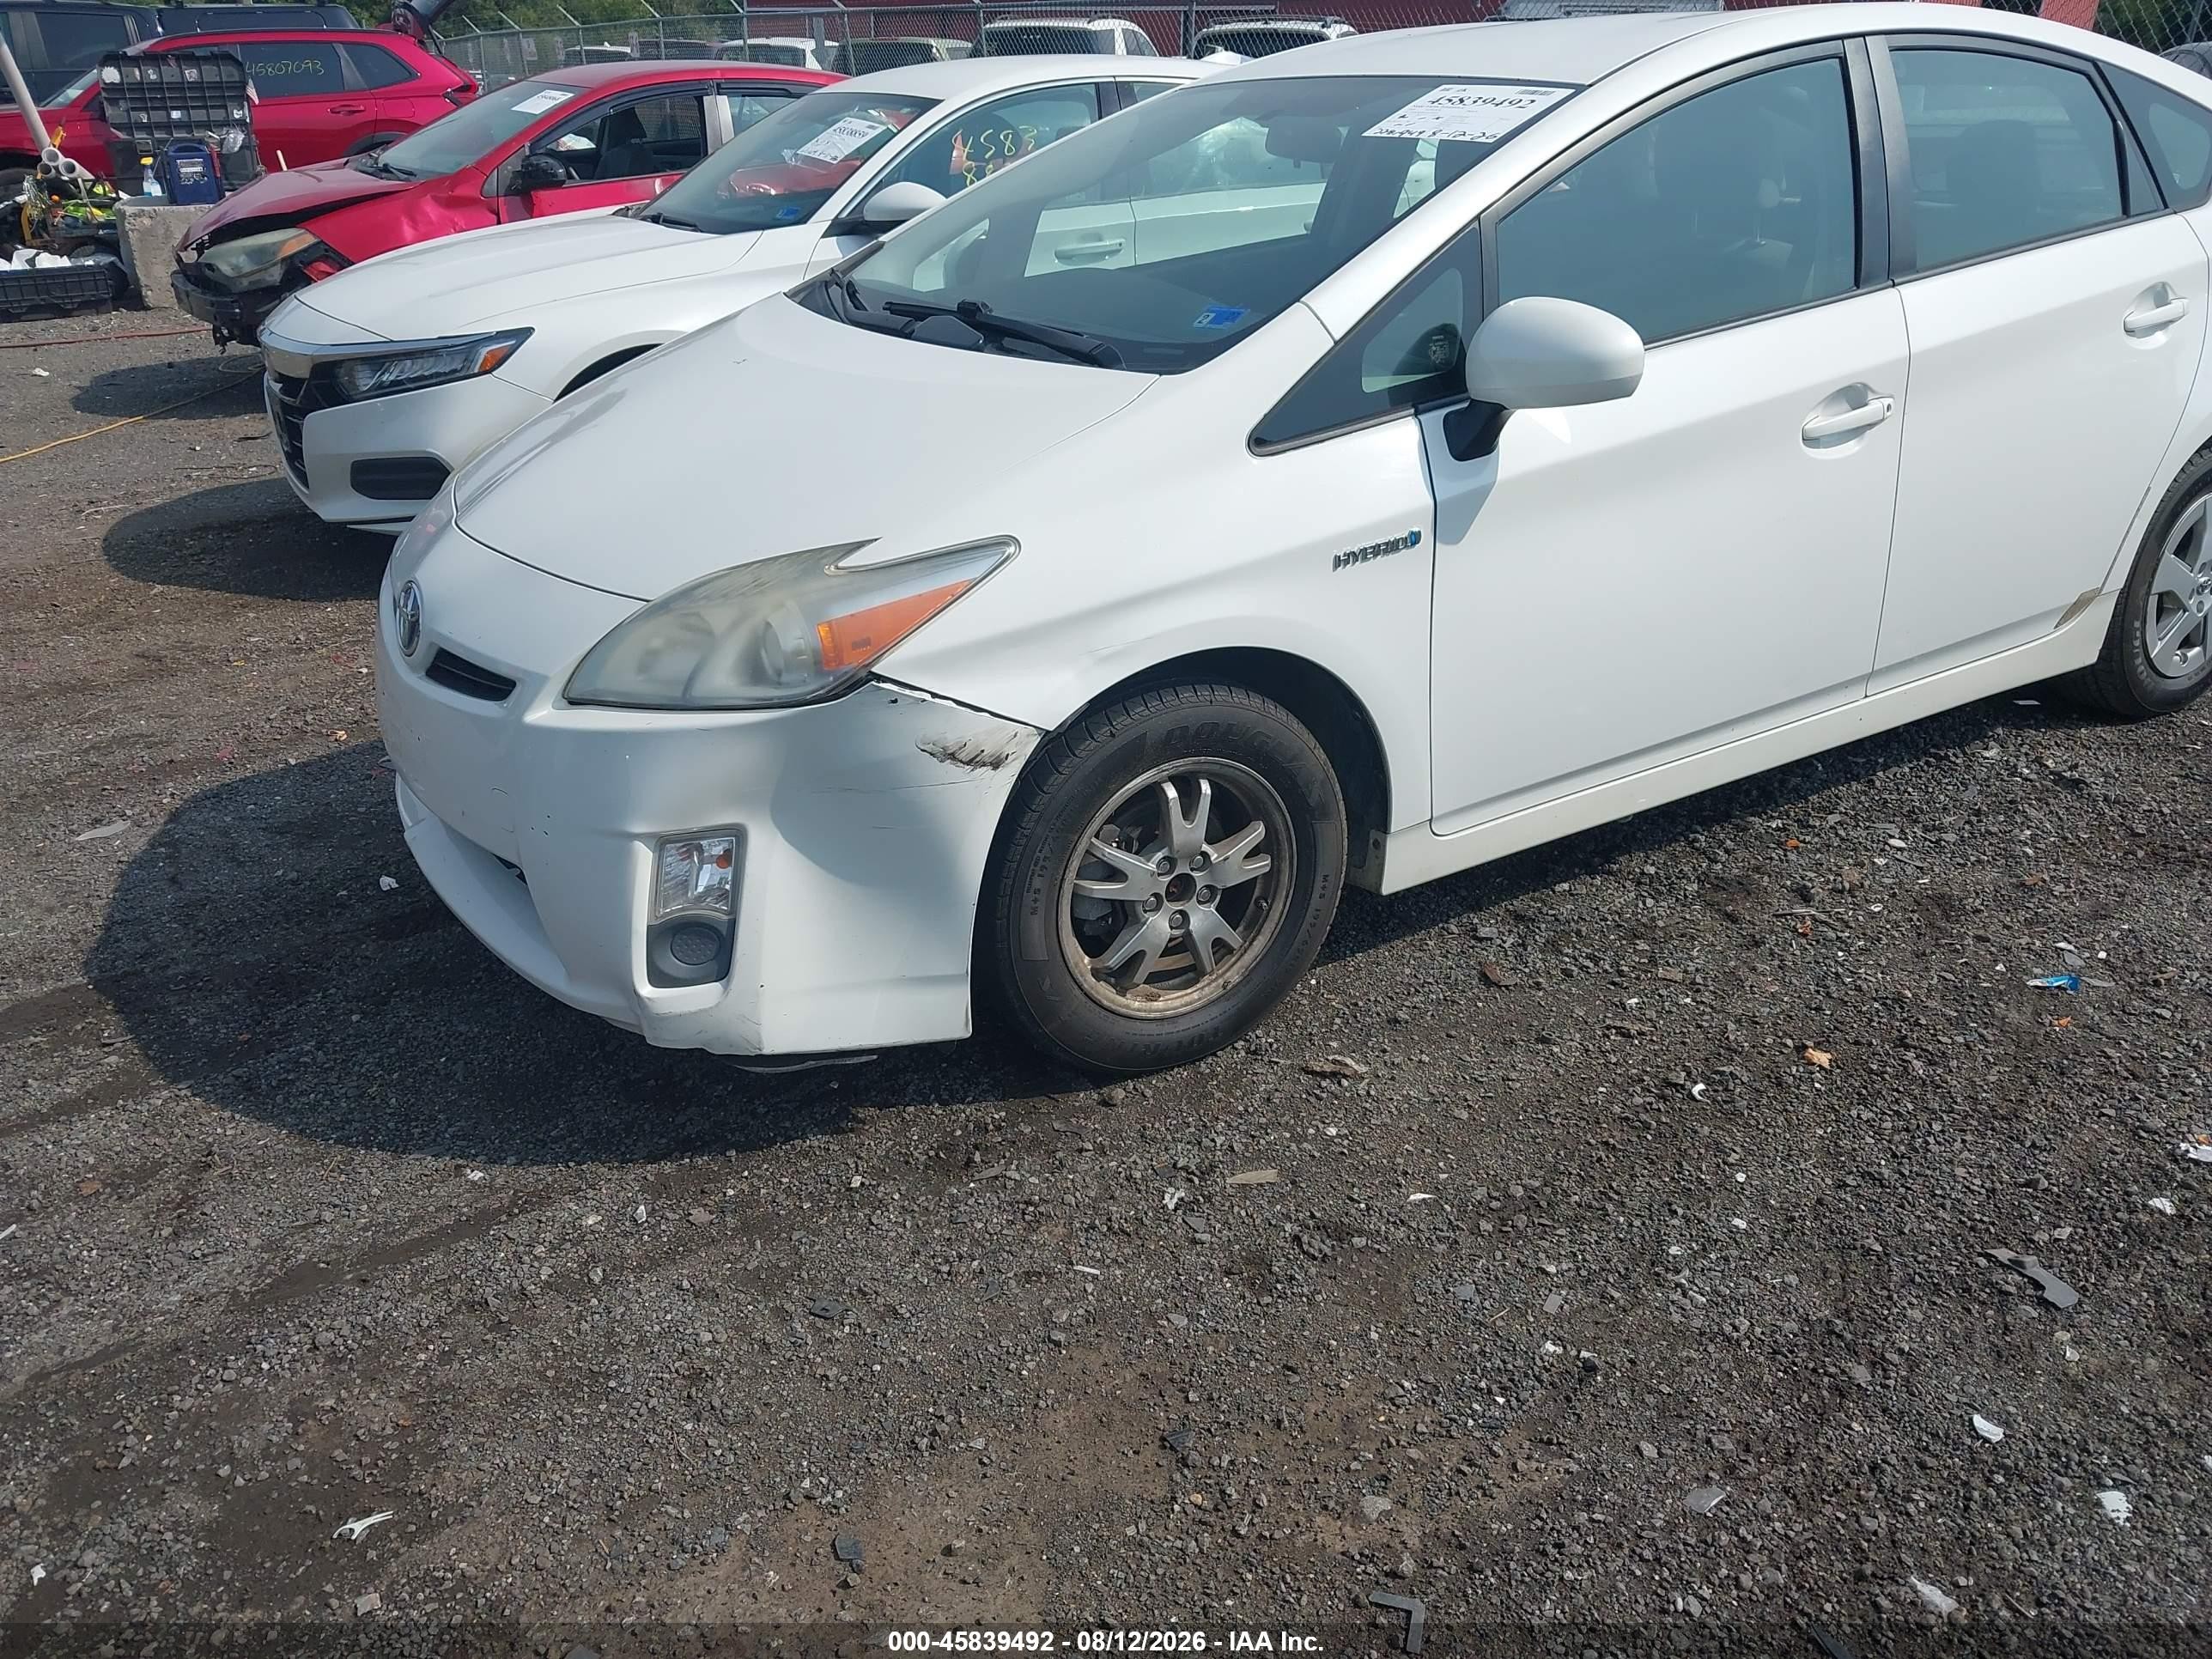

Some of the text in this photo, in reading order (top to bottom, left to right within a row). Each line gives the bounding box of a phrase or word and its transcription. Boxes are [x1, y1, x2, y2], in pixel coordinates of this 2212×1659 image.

[246, 59, 325, 76] 45807093
[1427, 95, 1536, 109] 45839492
[951, 125, 1037, 161] 4583
[1333, 536, 1409, 573] HYBRID
